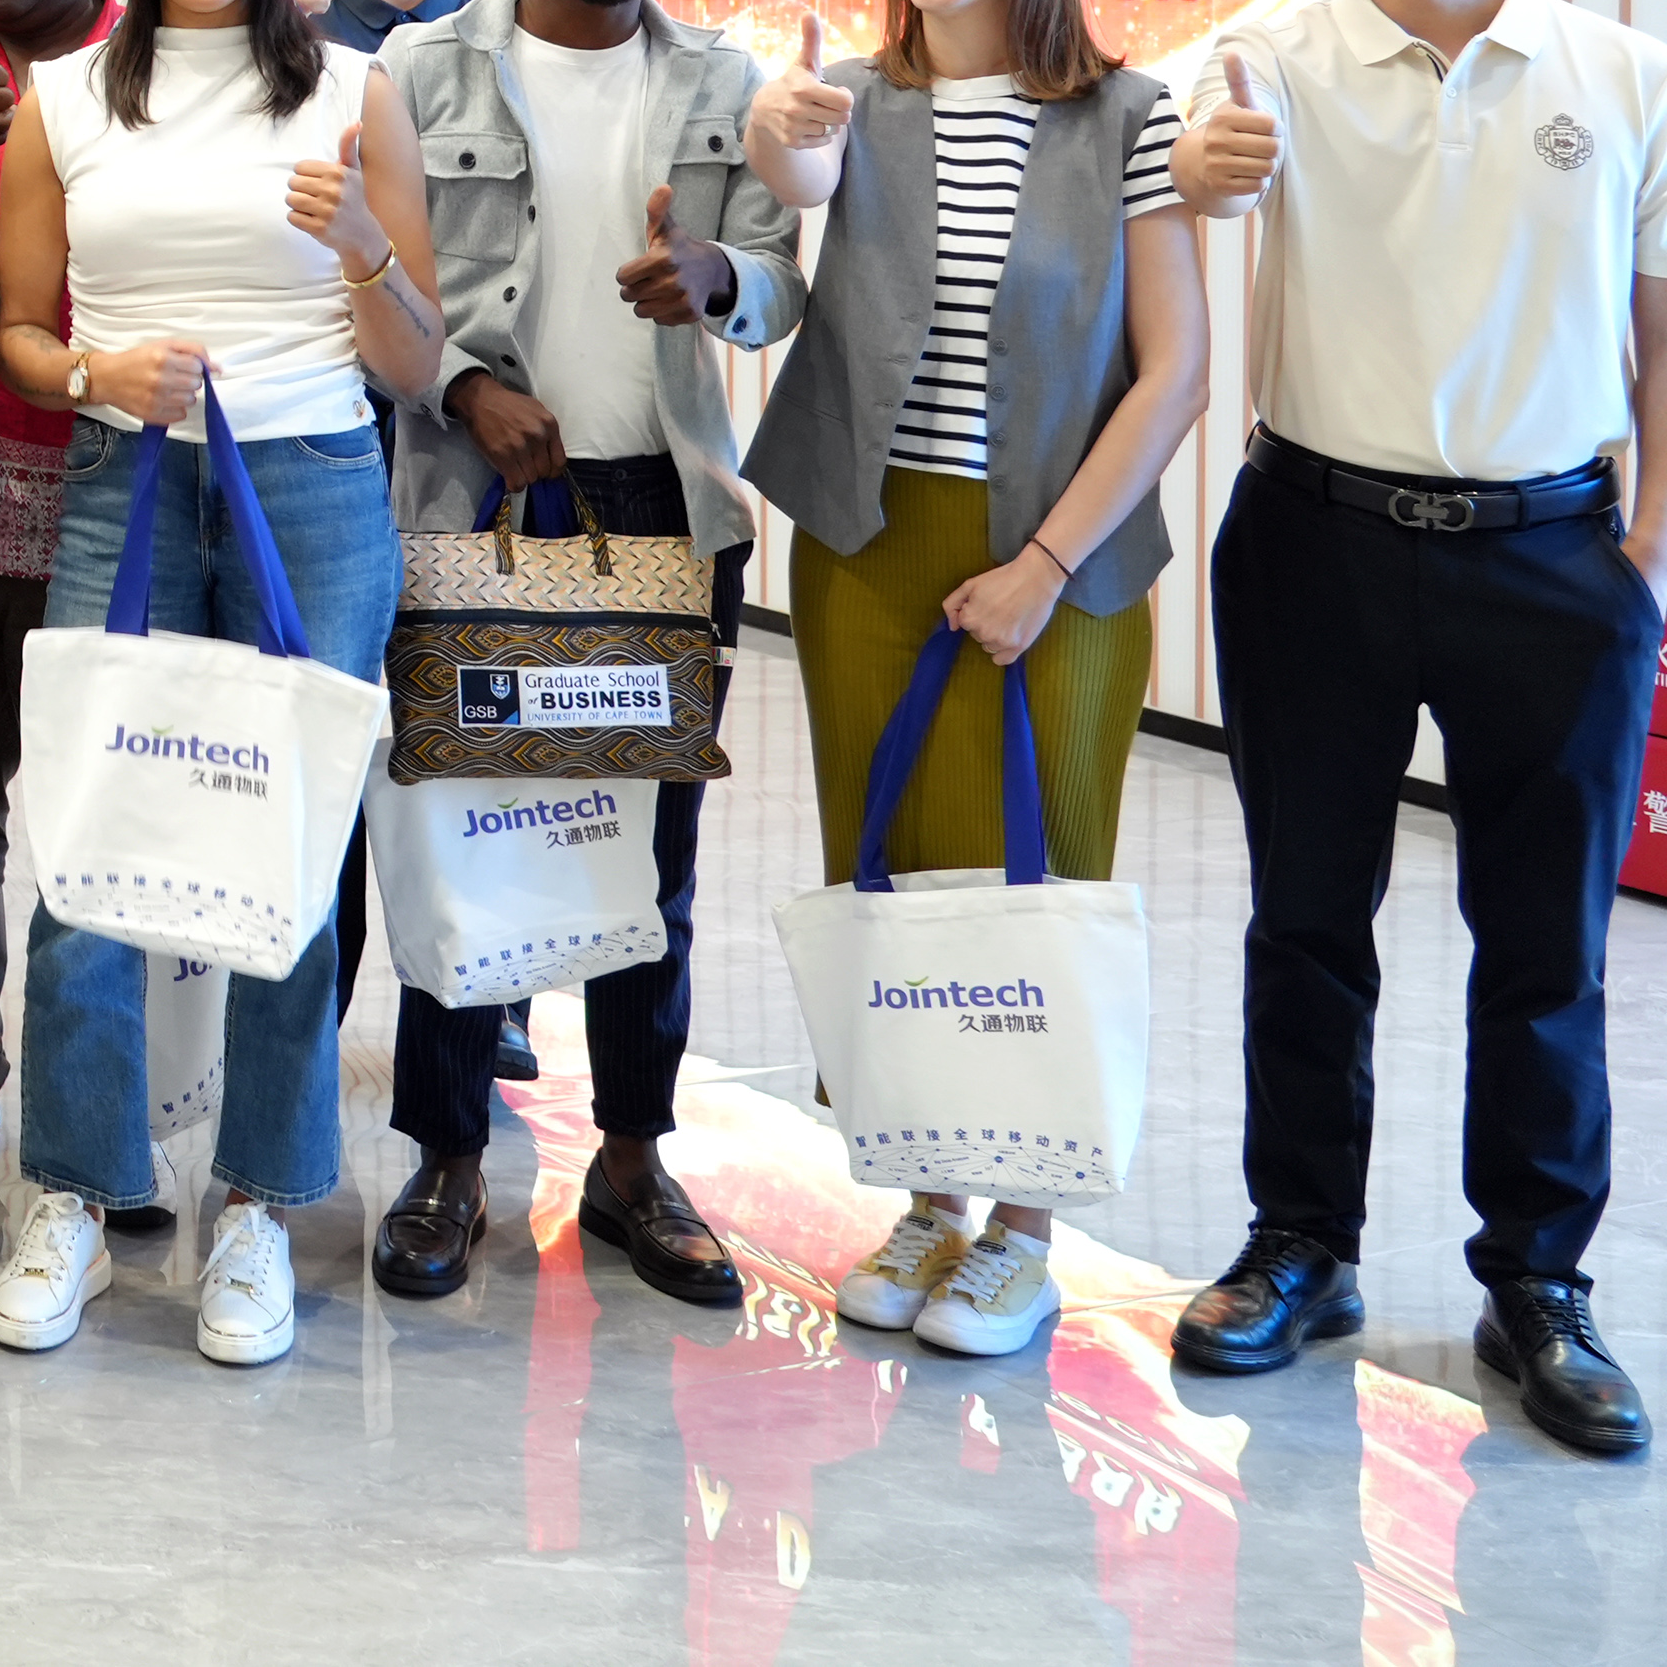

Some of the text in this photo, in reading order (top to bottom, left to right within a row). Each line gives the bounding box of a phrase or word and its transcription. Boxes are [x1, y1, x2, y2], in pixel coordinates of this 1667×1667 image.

[525, 671, 660, 688] Graduate School
[527, 690, 662, 709] of BUSINESS
[464, 705, 498, 719] GSB
[527, 710, 663, 722] UNIVERSITY OF CAPE TOWN
[105, 724, 269, 776] Jointech
[188, 767, 269, 802] 久通物联
[463, 790, 617, 837] Jointech
[545, 820, 622, 849] 久通物联
[868, 977, 1045, 1009] Jointech
[958, 1014, 1048, 1033] 久通物联
